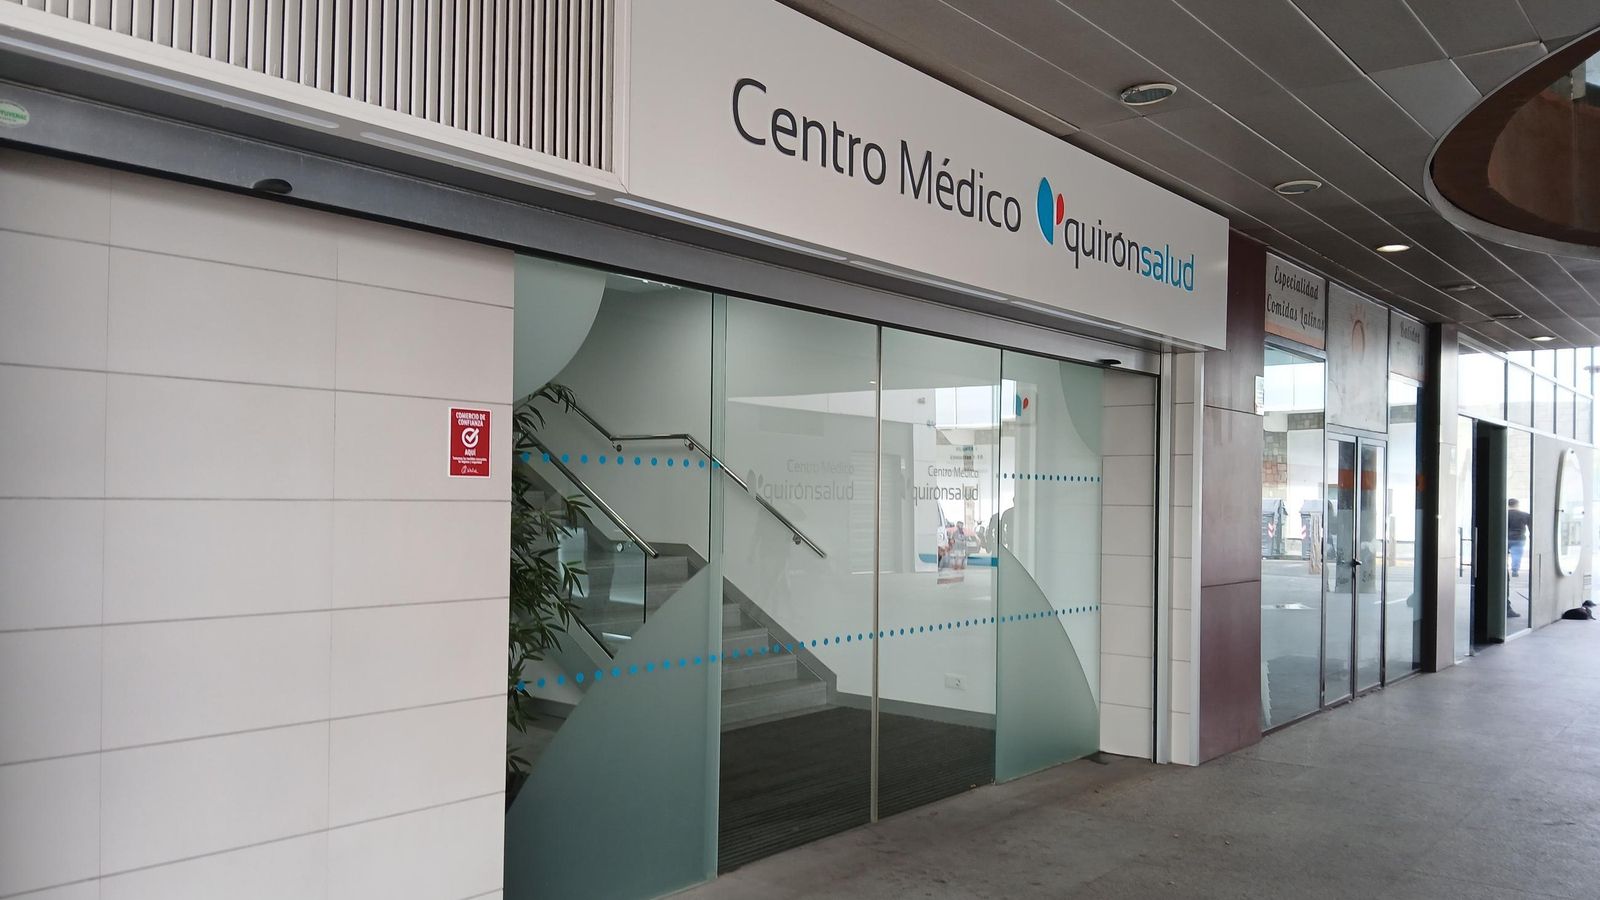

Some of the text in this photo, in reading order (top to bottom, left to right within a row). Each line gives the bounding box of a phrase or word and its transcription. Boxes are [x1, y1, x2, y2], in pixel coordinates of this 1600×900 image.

[732, 77, 1195, 291] Centro Médico quirónsalud
[1274, 265, 1319, 300] Especialidad
[1266, 293, 1325, 331] Comidas Latinas
